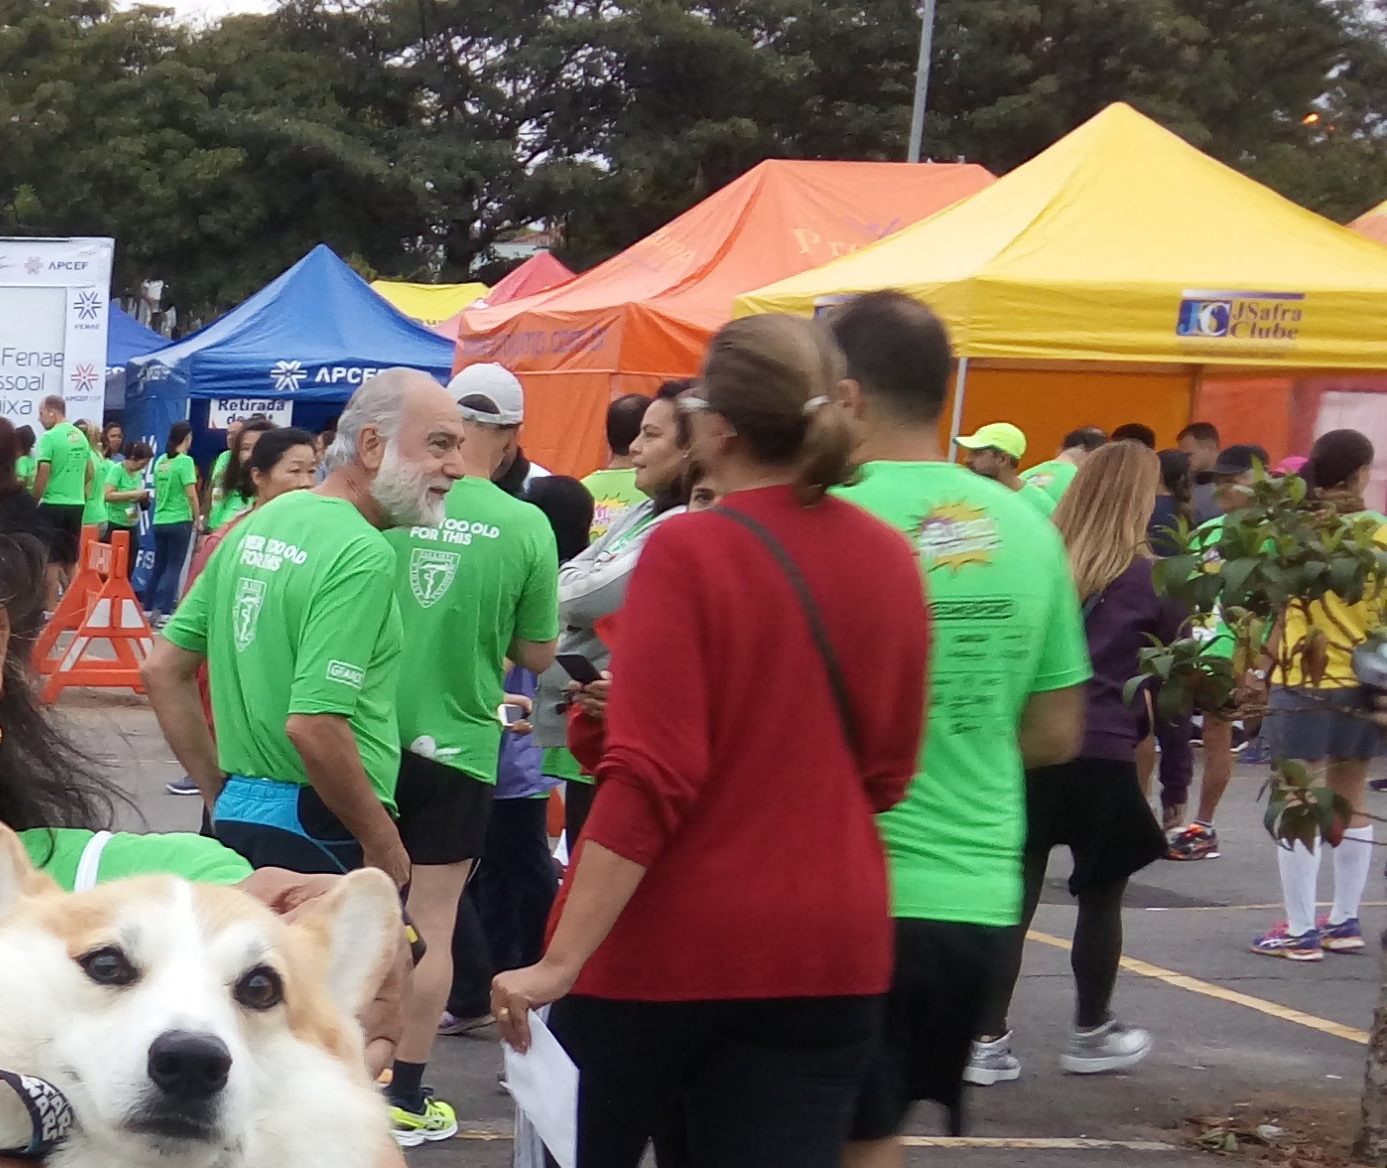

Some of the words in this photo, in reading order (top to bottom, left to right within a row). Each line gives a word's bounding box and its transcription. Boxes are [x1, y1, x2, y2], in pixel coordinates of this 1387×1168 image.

[48, 260, 89, 271] APCEF
[1230, 321, 1299, 339] Clube
[1, 347, 65, 368] Fenae
[218, 398, 285, 411] Retirada
[409, 526, 439, 541] FOR
[441, 529, 473, 546] THIS
[470, 522, 501, 539] OLD
